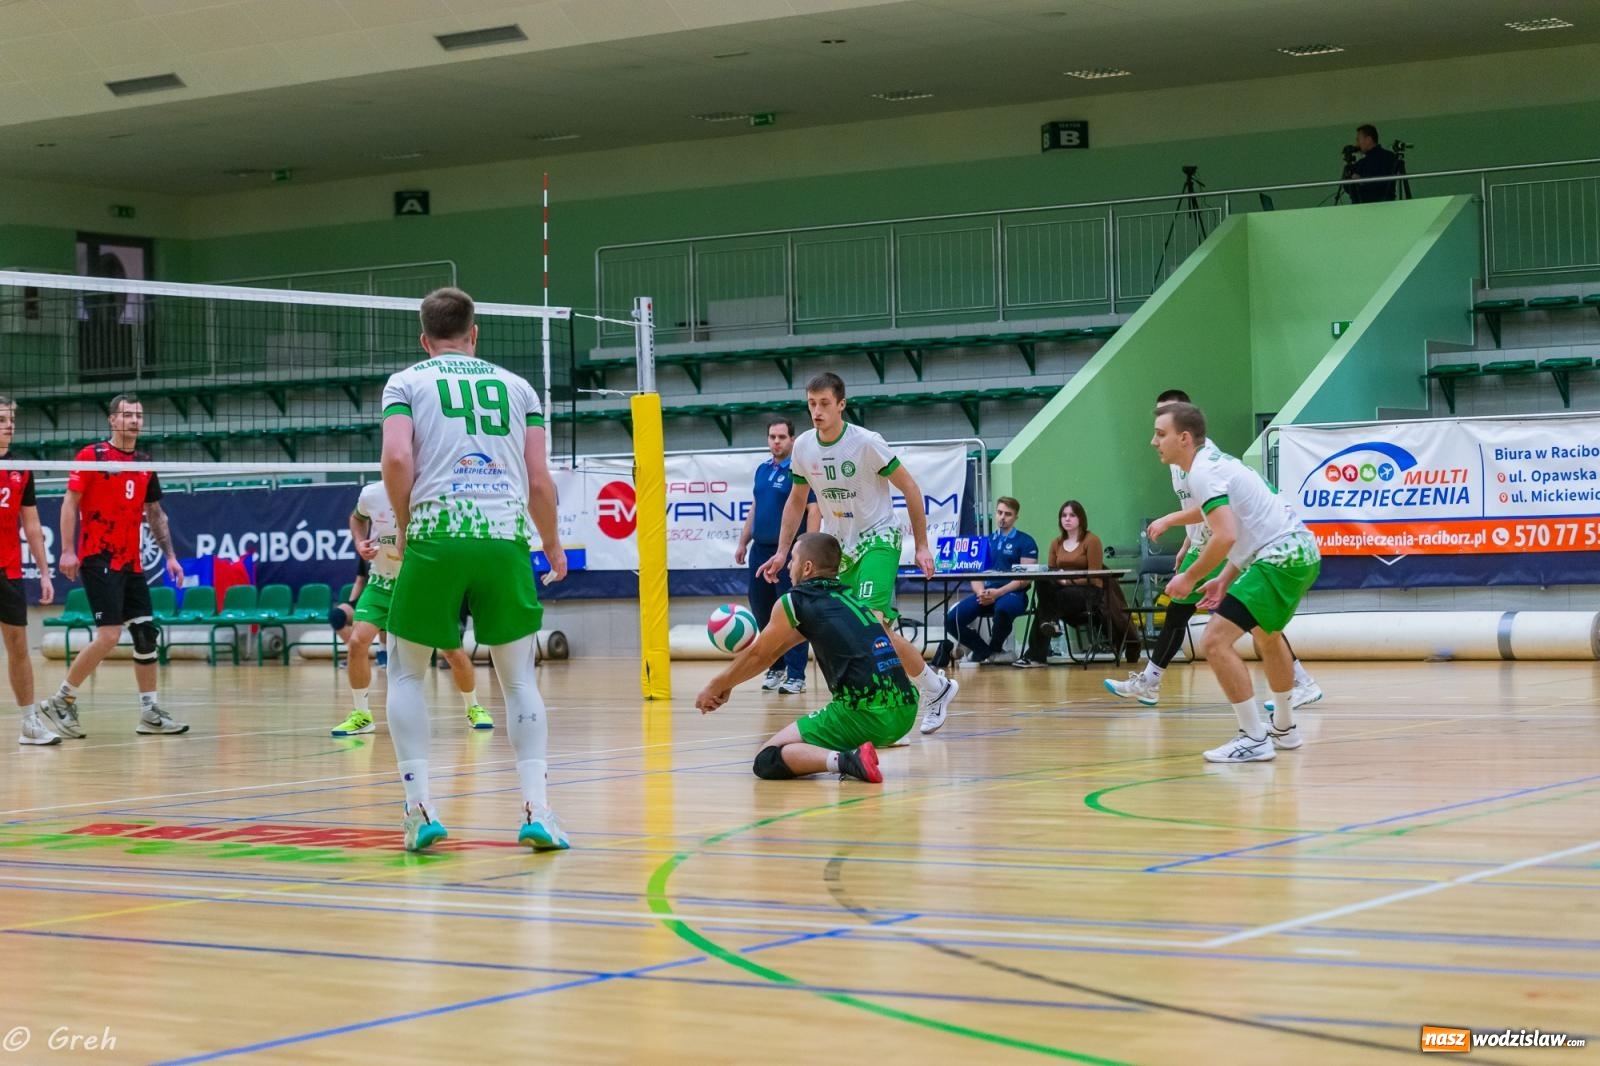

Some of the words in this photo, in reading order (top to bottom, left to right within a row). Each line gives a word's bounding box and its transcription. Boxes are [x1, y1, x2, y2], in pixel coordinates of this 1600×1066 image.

[1060, 130, 1080, 146] B
[401, 199, 424, 212] A
[436, 379, 511, 437] 49
[1495, 448, 1532, 461] Biura
[1535, 450, 1548, 459] w
[1551, 445, 1600, 459] Racibo
[824, 465, 836, 480] 10
[1404, 468, 1468, 485] MULTI
[1509, 470, 1527, 483] ul.
[1531, 468, 1597, 485] Opawska
[125, 480, 135, 499] 9
[1303, 486, 1470, 508] UBEZPIECZENIA
[1511, 490, 1528, 503] ul.
[196, 519, 356, 563] RACIBÓRZ
[1514, 523, 1551, 548] 570
[1554, 523, 1578, 546] 77
[1584, 522, 1600, 545] 5
[942, 541, 951, 558] 4
[970, 541, 979, 558] 5
[954, 560, 983, 571] utterfly
[860, 581, 874, 598] 10
